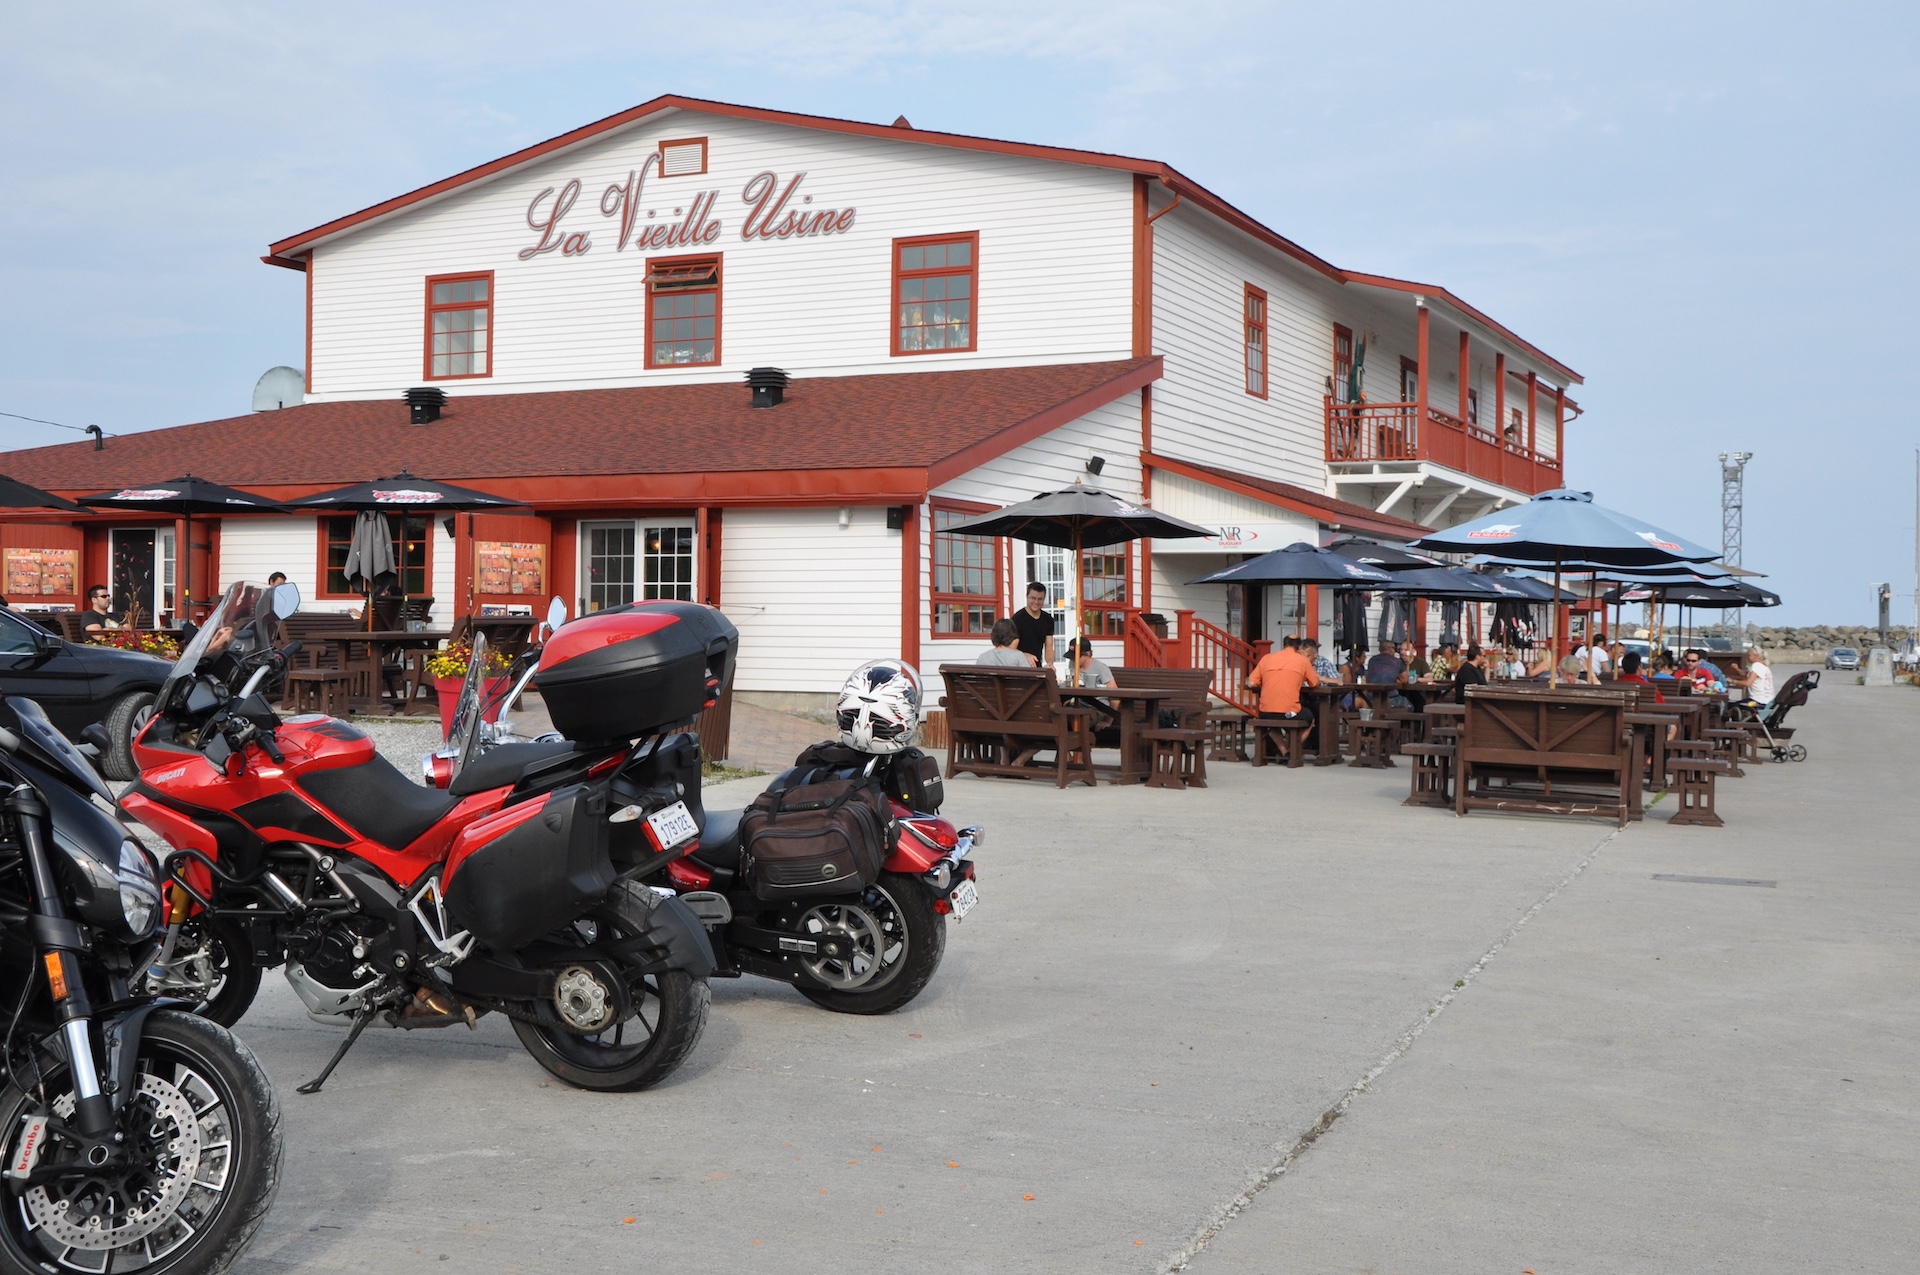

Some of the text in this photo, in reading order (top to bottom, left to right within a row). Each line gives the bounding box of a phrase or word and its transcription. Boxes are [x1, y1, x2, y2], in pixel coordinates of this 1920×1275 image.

[518, 151, 856, 261] La Vieille Usine
[156, 767, 187, 784] DUCATI
[661, 814, 691, 840] 17912E
